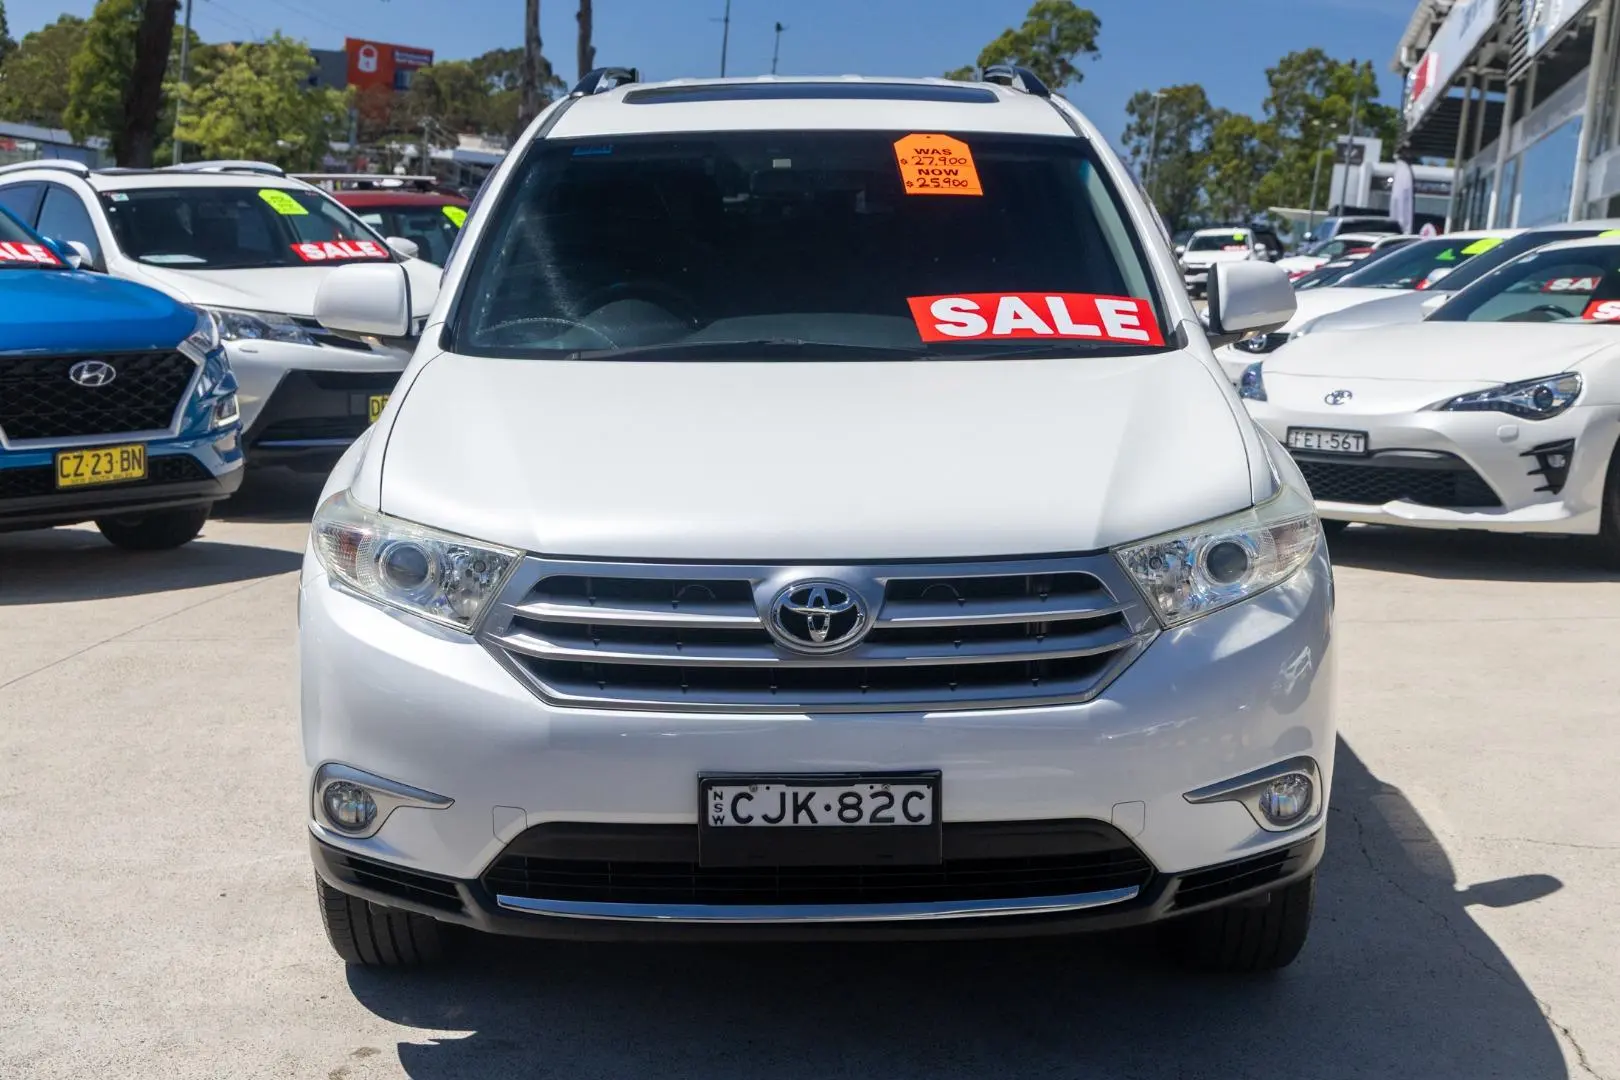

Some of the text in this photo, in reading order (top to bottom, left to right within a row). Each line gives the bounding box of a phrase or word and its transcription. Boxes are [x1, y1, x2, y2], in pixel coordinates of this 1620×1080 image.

[917, 168, 959, 176] NOW
[300, 241, 385, 260] SALE
[930, 296, 1150, 341] SALE
